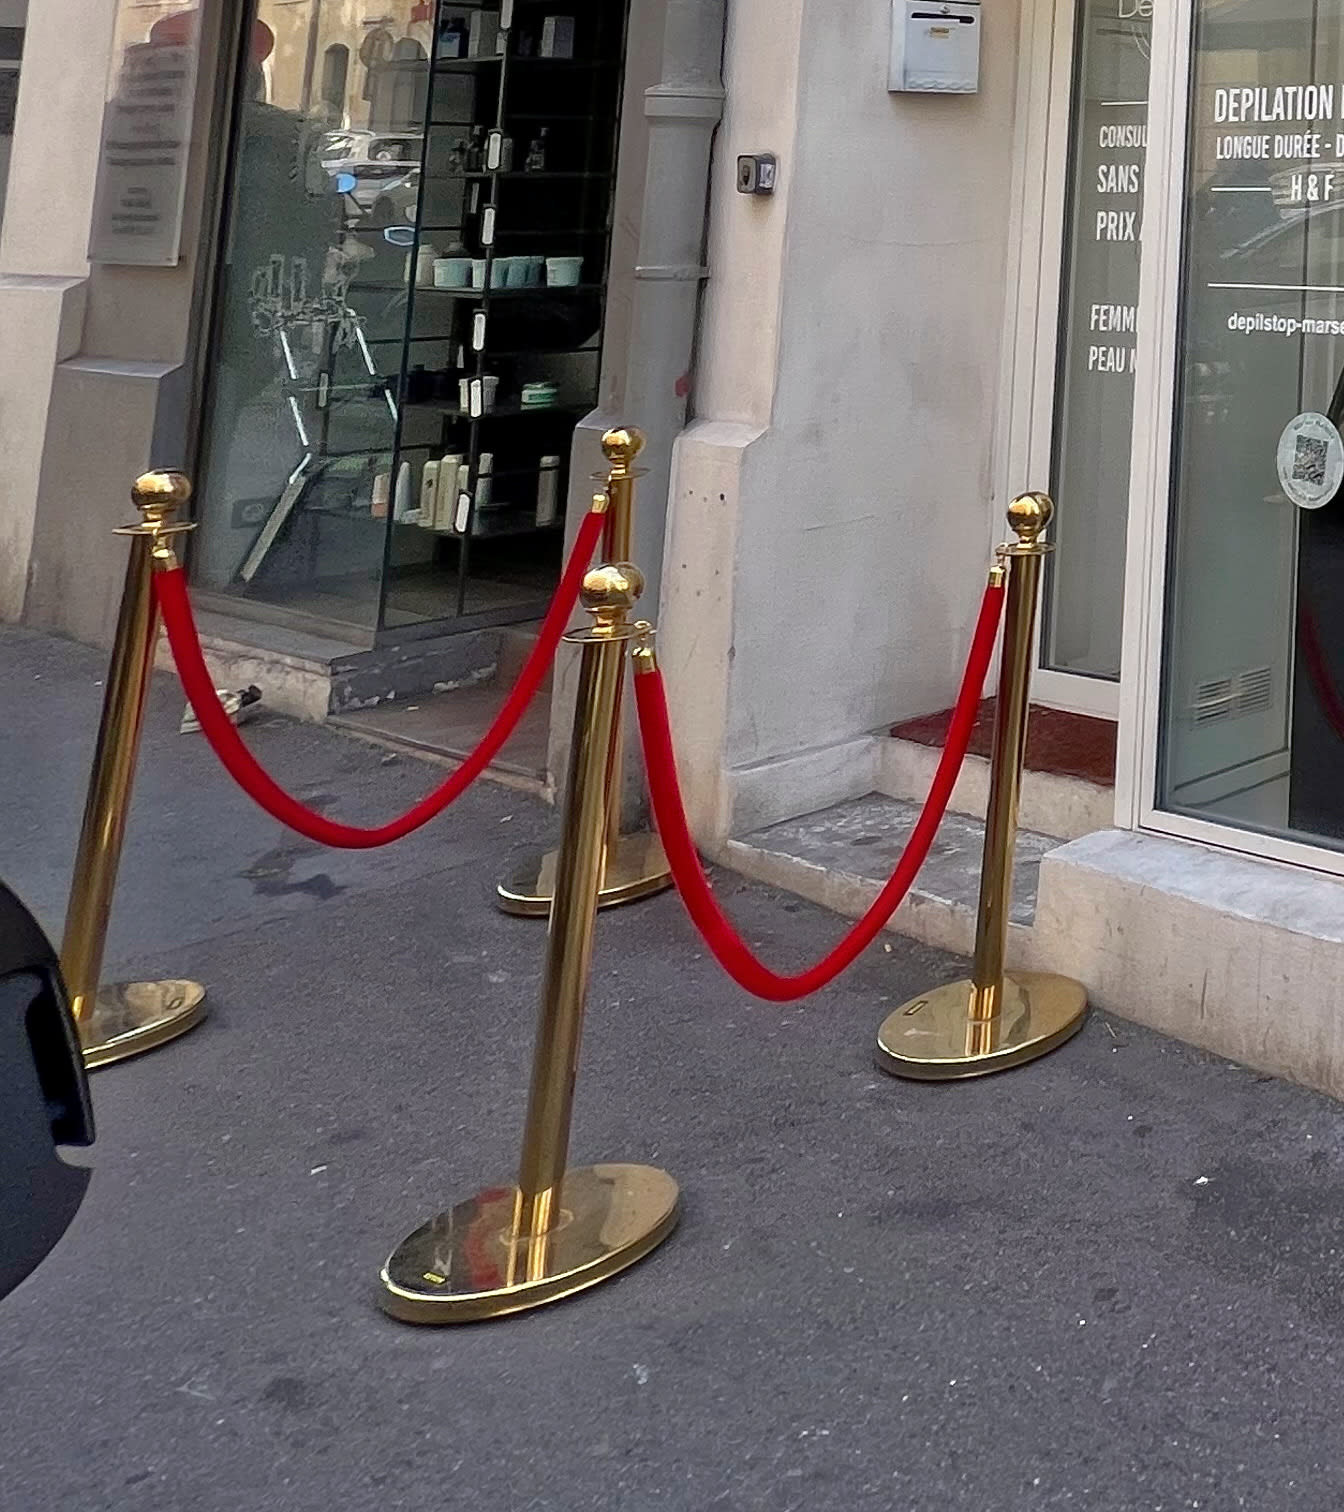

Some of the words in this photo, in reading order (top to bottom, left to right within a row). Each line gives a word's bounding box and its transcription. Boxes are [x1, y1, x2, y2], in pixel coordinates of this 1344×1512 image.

[1213, 84, 1334, 123] DEPILATION
[1215, 135, 1271, 160] LONGUE
[1273, 130, 1321, 159] DURÉE
[1096, 164, 1140, 193] SANS
[1290, 174, 1303, 201] H
[1307, 174, 1320, 201] &
[1095, 210, 1136, 241] PRIX
[1087, 345, 1126, 373] PEAU
